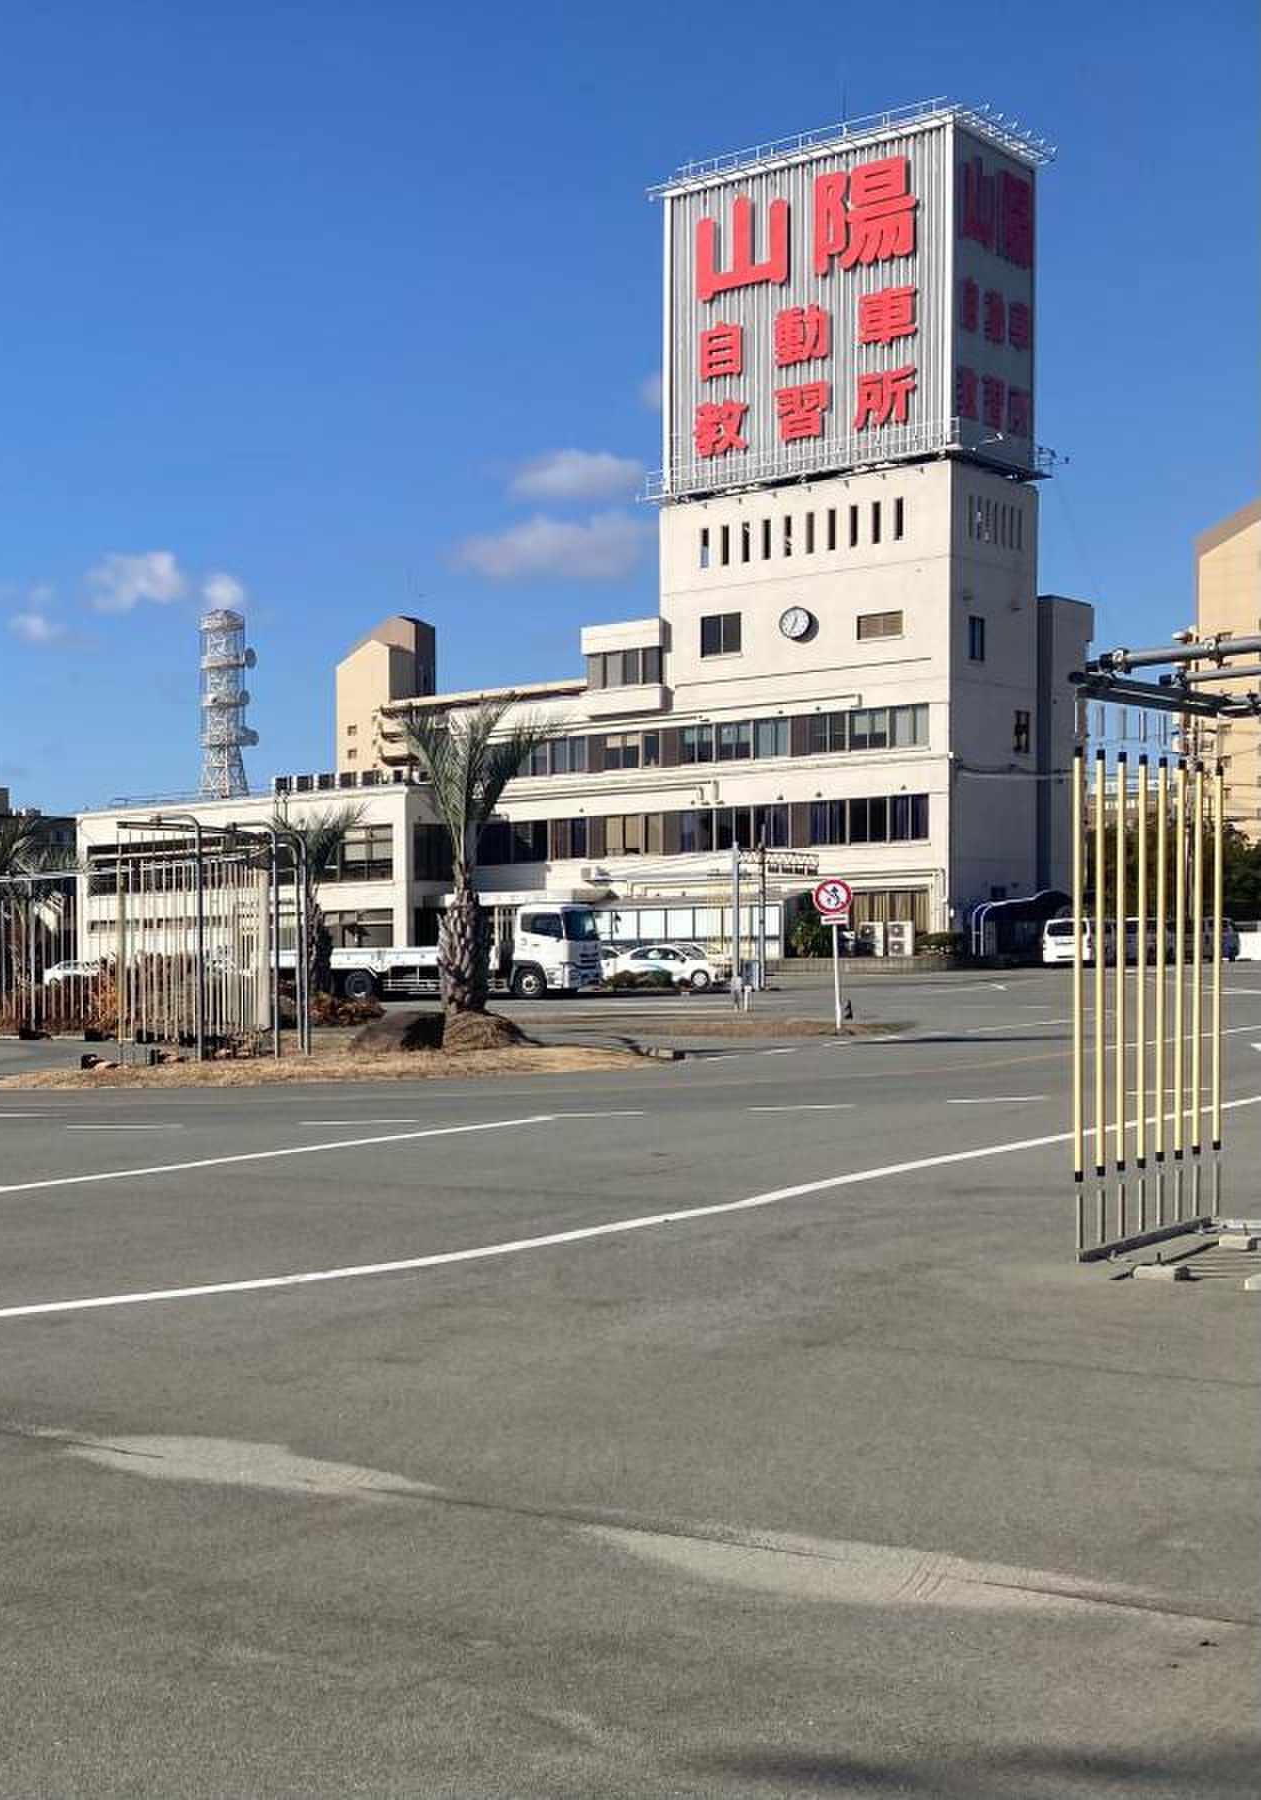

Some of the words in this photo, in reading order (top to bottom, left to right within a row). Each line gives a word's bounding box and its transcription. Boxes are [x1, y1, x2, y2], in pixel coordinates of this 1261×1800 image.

[695, 155, 917, 302] 山陽
[698, 285, 917, 380] 自動車
[693, 366, 916, 458] 教習所
